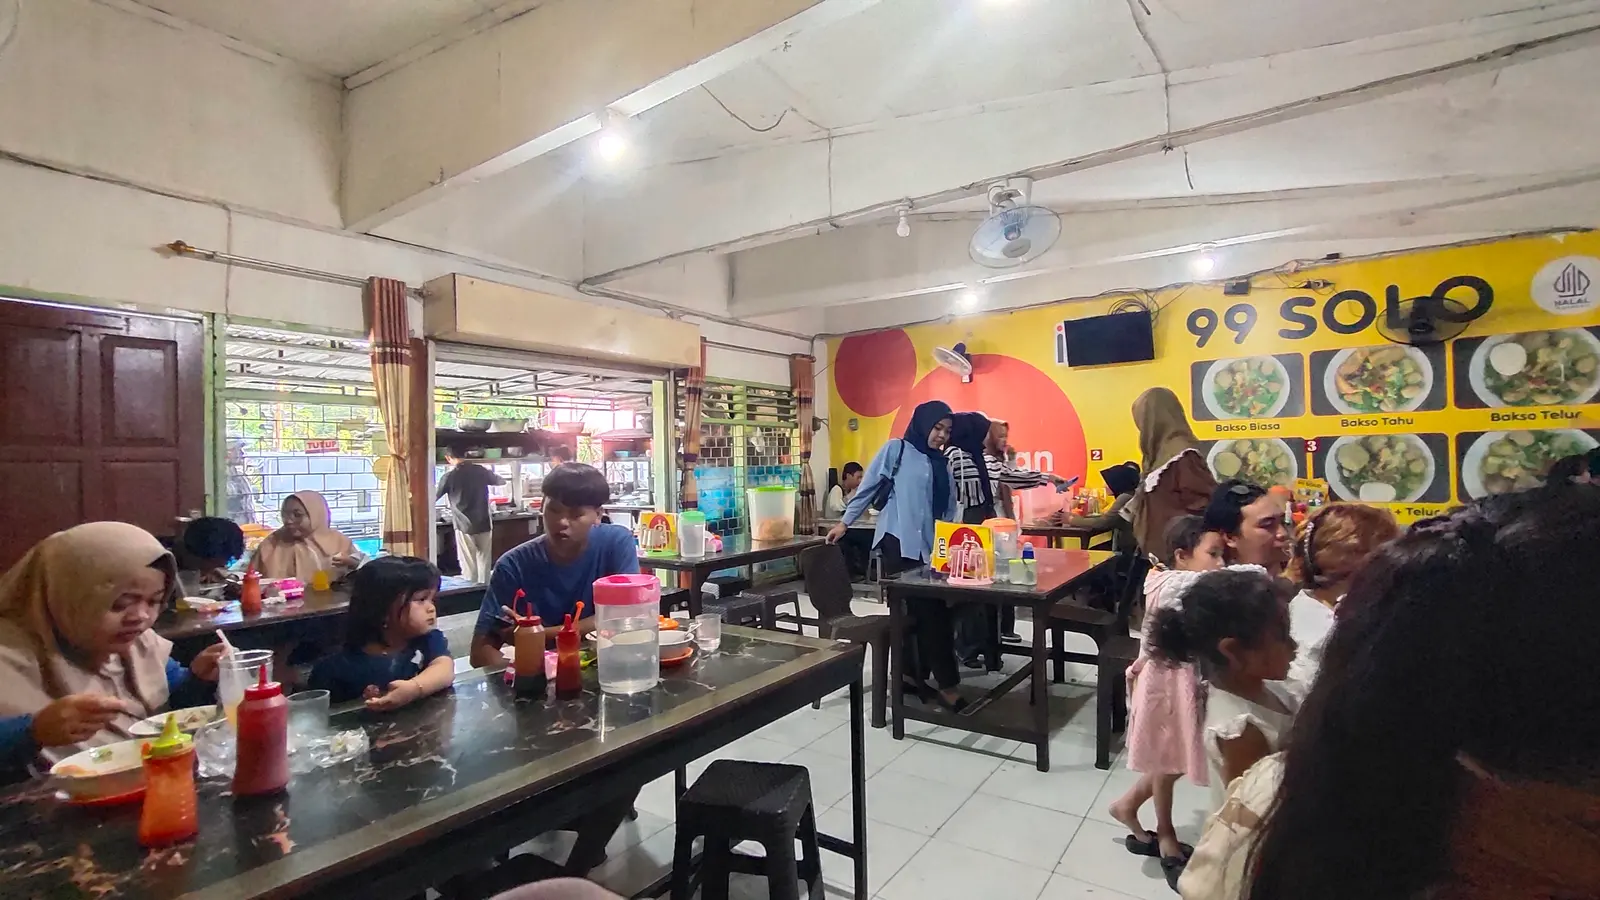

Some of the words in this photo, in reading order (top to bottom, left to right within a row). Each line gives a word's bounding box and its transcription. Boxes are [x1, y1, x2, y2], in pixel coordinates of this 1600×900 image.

[1186, 303, 1258, 349] 99
[1278, 275, 1494, 340] SOLO
[1490, 412, 1537, 422] Bakso
[1540, 409, 1583, 420] Telur
[1215, 424, 1247, 432] Bakso
[1249, 422, 1281, 431] Biasa
[1341, 417, 1378, 428] Bakso
[1380, 416, 1414, 426] Tahu
[1306, 440, 1318, 452] 3
[1092, 451, 1102, 460] 2
[1406, 507, 1440, 517] Telur
